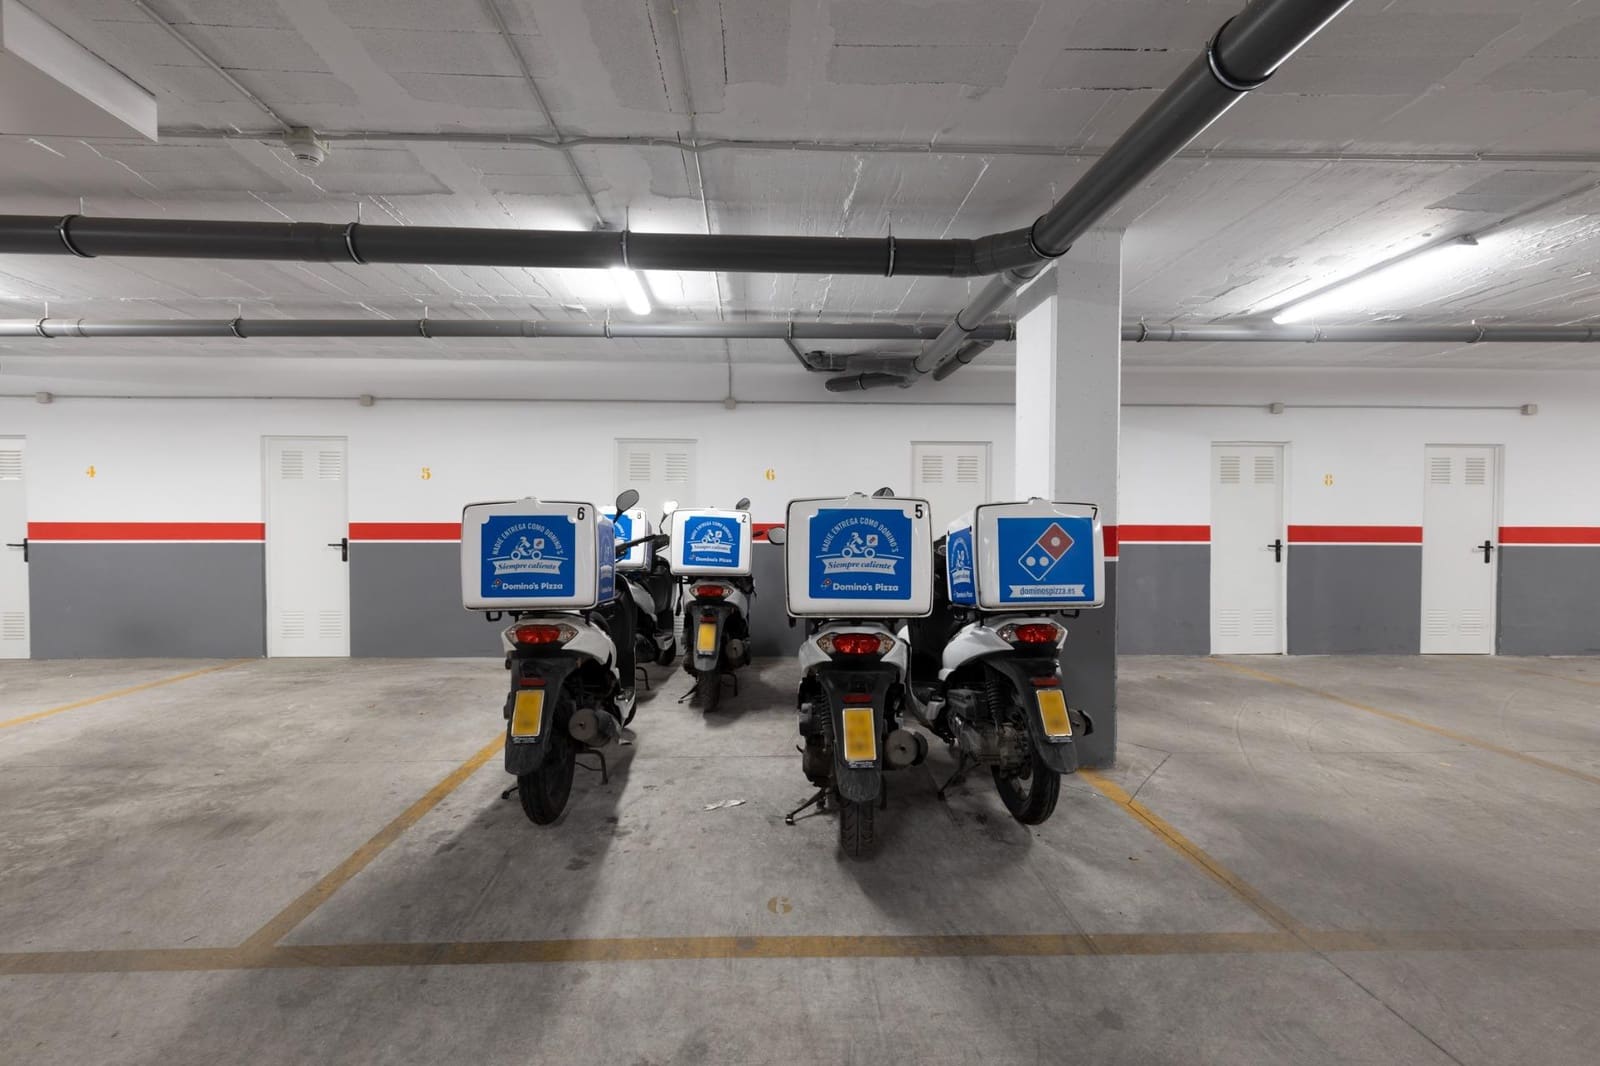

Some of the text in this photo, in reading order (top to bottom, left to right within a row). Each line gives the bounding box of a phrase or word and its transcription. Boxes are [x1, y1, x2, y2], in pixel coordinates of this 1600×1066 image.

[85, 465, 97, 479] 4
[420, 467, 432, 481] 5
[764, 469, 776, 481] 6
[1323, 473, 1334, 486] 8
[577, 506, 586, 521] 6
[914, 504, 924, 519] 5
[1091, 507, 1098, 520] 7
[741, 514, 747, 523] 2
[501, 522, 527, 540] ENTREGA
[527, 522, 545, 533] COMO
[821, 534, 835, 553] NADIE
[831, 517, 859, 536] ENTREGA
[859, 517, 879, 529] COMO
[497, 561, 557, 571] Siempre caliente
[827, 561, 892, 570] Siempre caliente
[502, 582, 563, 590] Domino's Pizza
[832, 582, 899, 592] Domino's Pizza
[1019, 585, 1076, 596] dominospizza.es
[767, 895, 793, 915] 6
